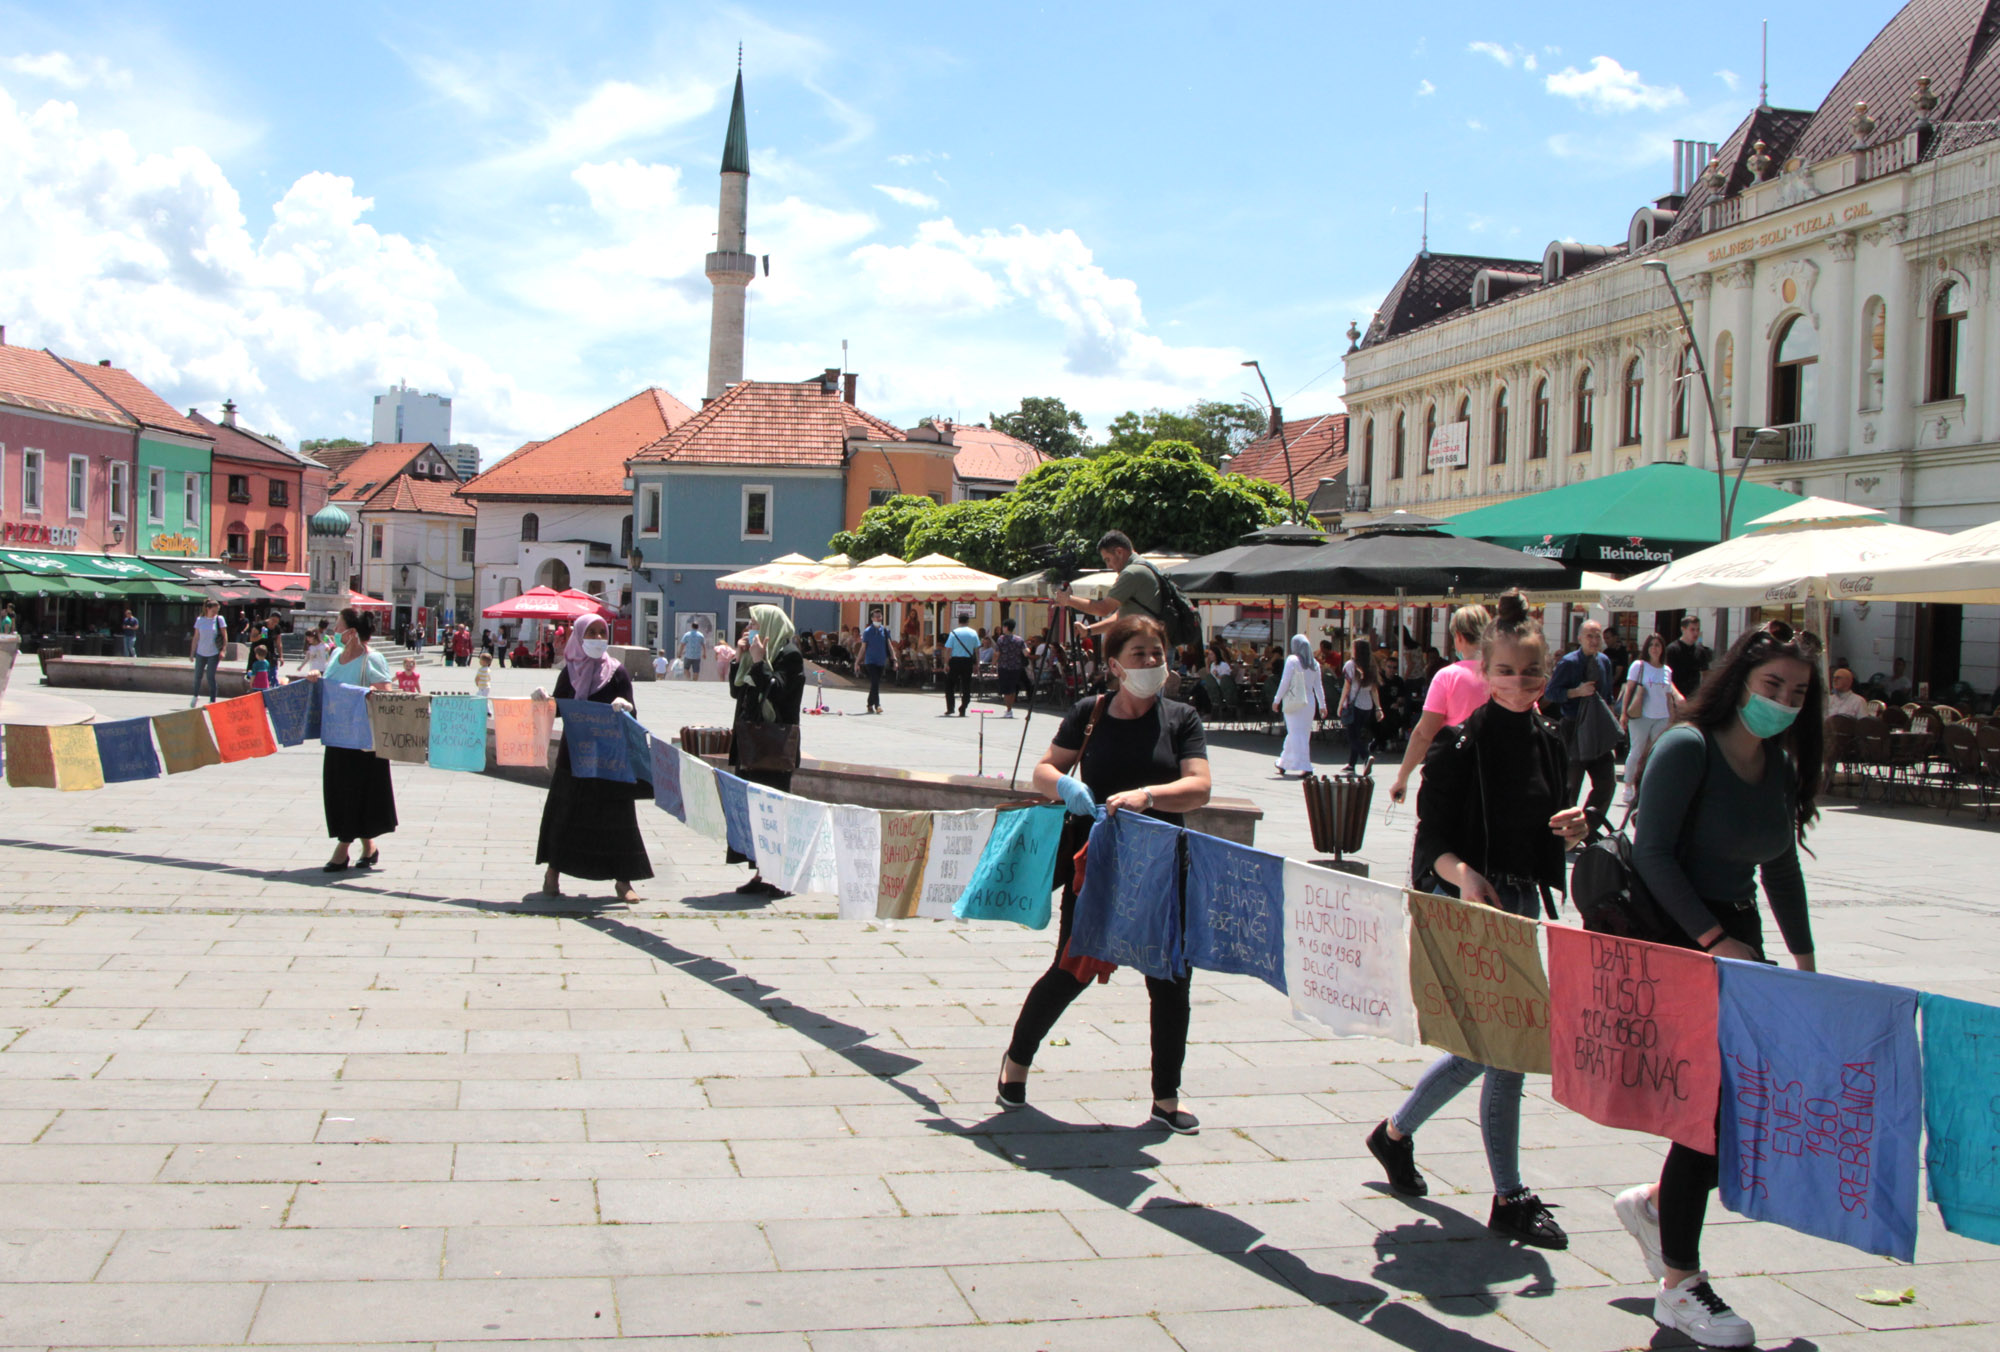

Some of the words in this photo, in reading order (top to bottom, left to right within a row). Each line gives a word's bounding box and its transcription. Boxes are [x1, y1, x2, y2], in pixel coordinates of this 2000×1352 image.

[1708, 238, 1754, 263] SALINES
[1759, 226, 1787, 247] SOLI
[1793, 212, 1835, 235] TUZLA
[1600, 546, 1672, 562] Heineken
[1305, 884, 1351, 911] DELIĆ
[1296, 909, 1379, 944] HAJRUDIN
[1456, 941, 1507, 983] 1960
[1303, 979, 1392, 1017] SREBRENICA
[1592, 973, 1656, 1018] HUSO
[1575, 1036, 1692, 1102] BRATUNAC
[1771, 1077, 1804, 1158] ENES
[1804, 1097, 1841, 1158] 1960
[1837, 1060, 1877, 1220] SREBRENICA
